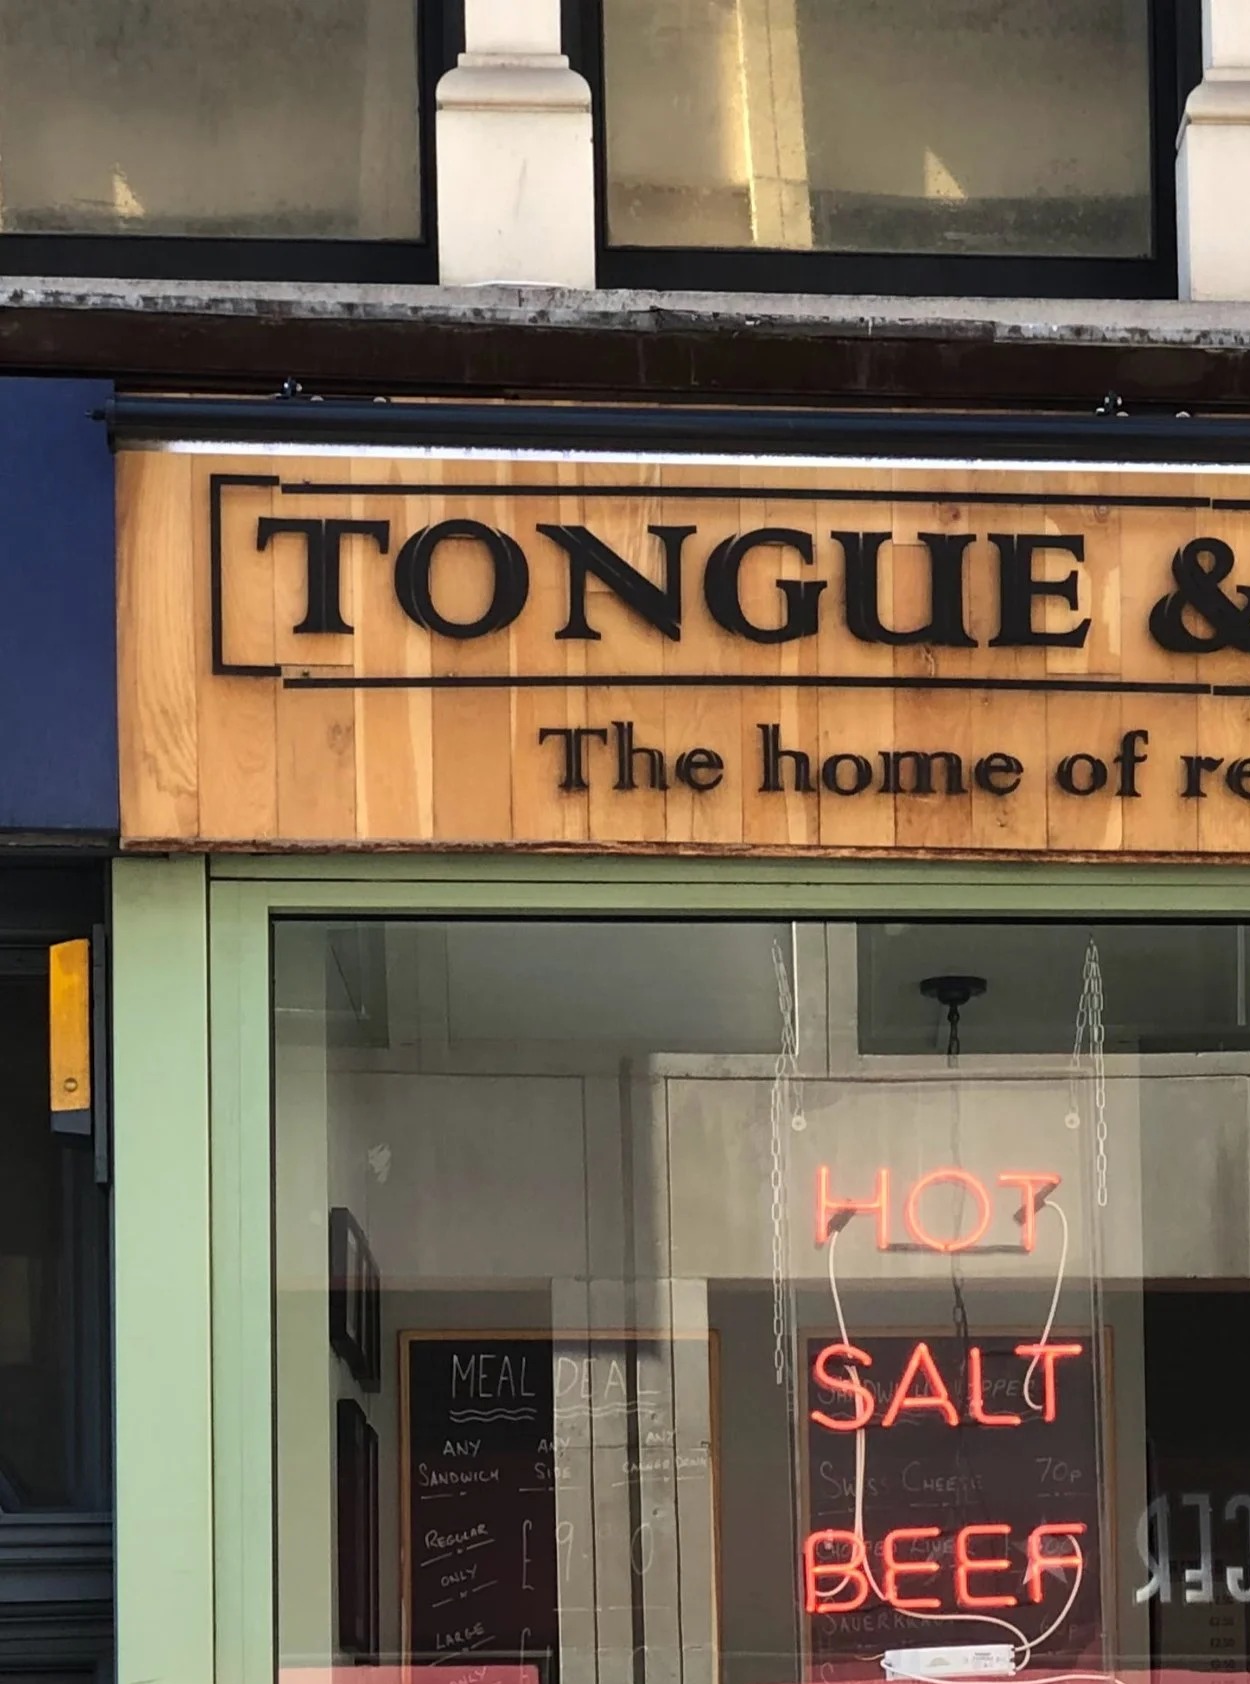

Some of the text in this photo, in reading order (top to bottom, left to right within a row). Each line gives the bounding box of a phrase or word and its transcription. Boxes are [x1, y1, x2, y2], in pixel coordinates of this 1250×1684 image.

[256, 517, 1092, 648] TONGUE
[539, 722, 724, 793] The
[757, 724, 1023, 801] home
[1058, 729, 1149, 798] of
[814, 1165, 1062, 1252] HOT
[451, 1354, 660, 1400] MEAL DEAL
[810, 1341, 1084, 1432] SALT
[442, 1437, 482, 1458] ANY
[418, 1462, 501, 1488] SANDWICH
[819, 1460, 891, 1499] SWSS
[425, 1523, 489, 1550] REGULAR
[440, 1563, 478, 1588] ONLY
[802, 1522, 1087, 1613] BEEF
[435, 1621, 486, 1650] LARGE
